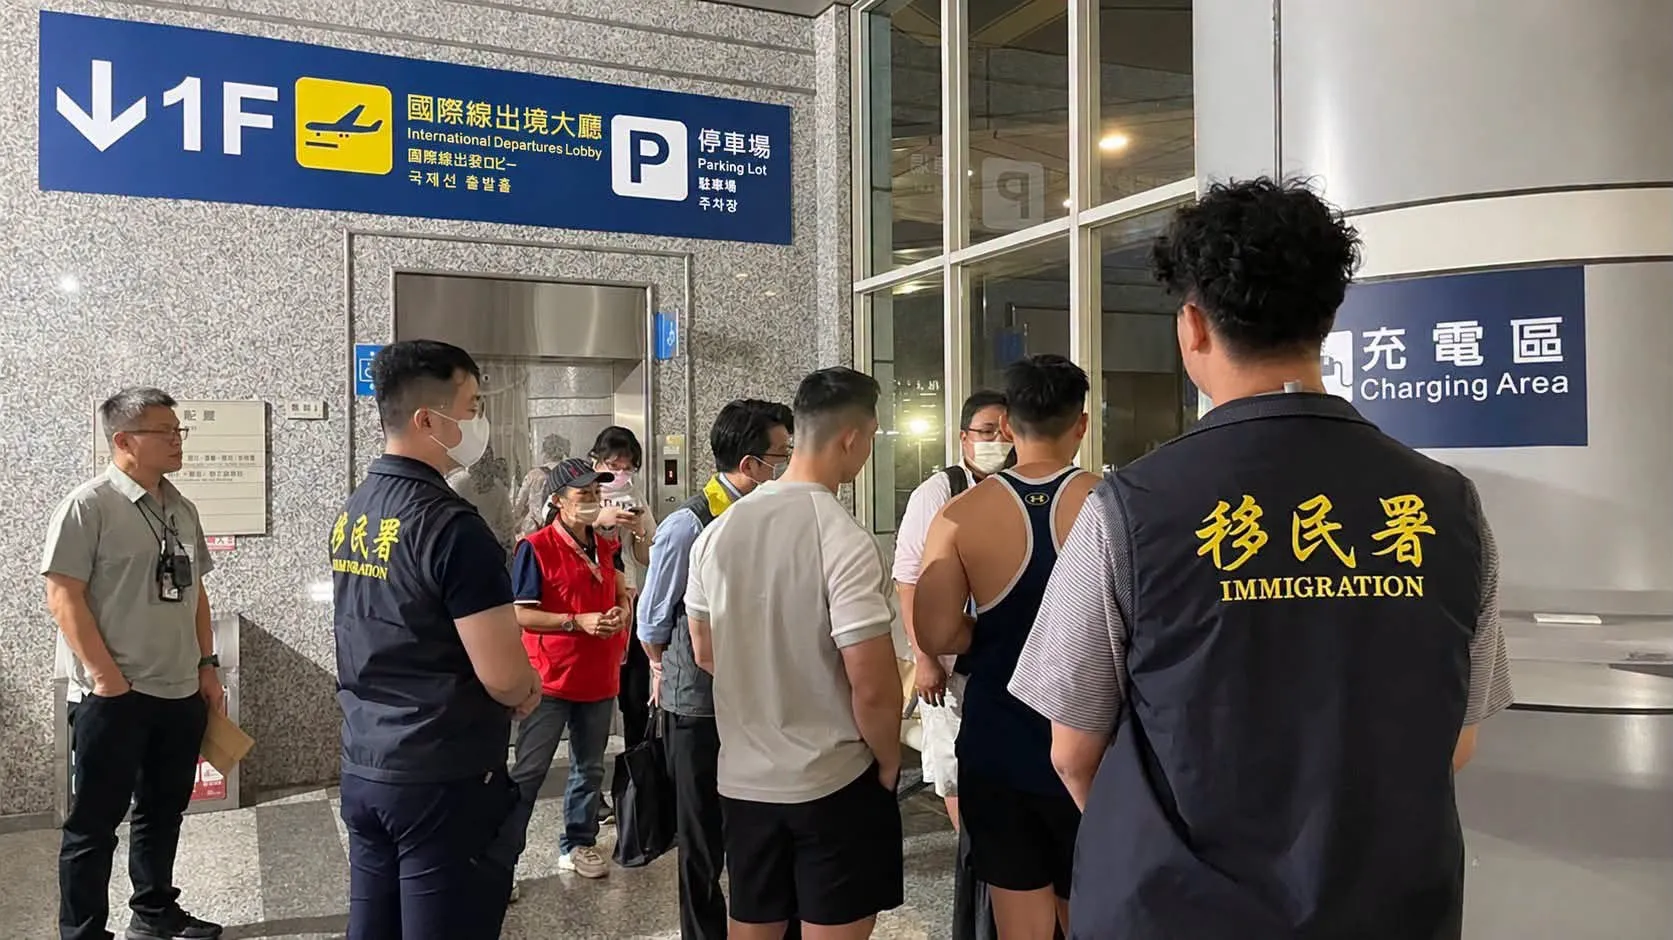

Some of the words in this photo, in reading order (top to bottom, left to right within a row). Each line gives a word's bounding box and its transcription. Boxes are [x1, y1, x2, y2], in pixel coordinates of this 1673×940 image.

[163, 76, 279, 155] 1F
[407, 93, 602, 140] 國際線出境大廳
[407, 127, 491, 147] International
[494, 136, 563, 155] Departures
[565, 143, 602, 160] Lobby
[629, 129, 670, 184] P
[698, 127, 771, 159] 停車場
[408, 170, 457, 188] 국제선
[698, 157, 744, 175] Parking
[747, 162, 768, 176] Lot
[699, 196, 738, 213] 주차장
[1361, 316, 1564, 372] 充電區
[1360, 373, 1488, 403] Charging
[1496, 372, 1569, 395] Area
[1195, 494, 1436, 571] 移民署
[1220, 575, 1424, 601] IMMIGRATION
